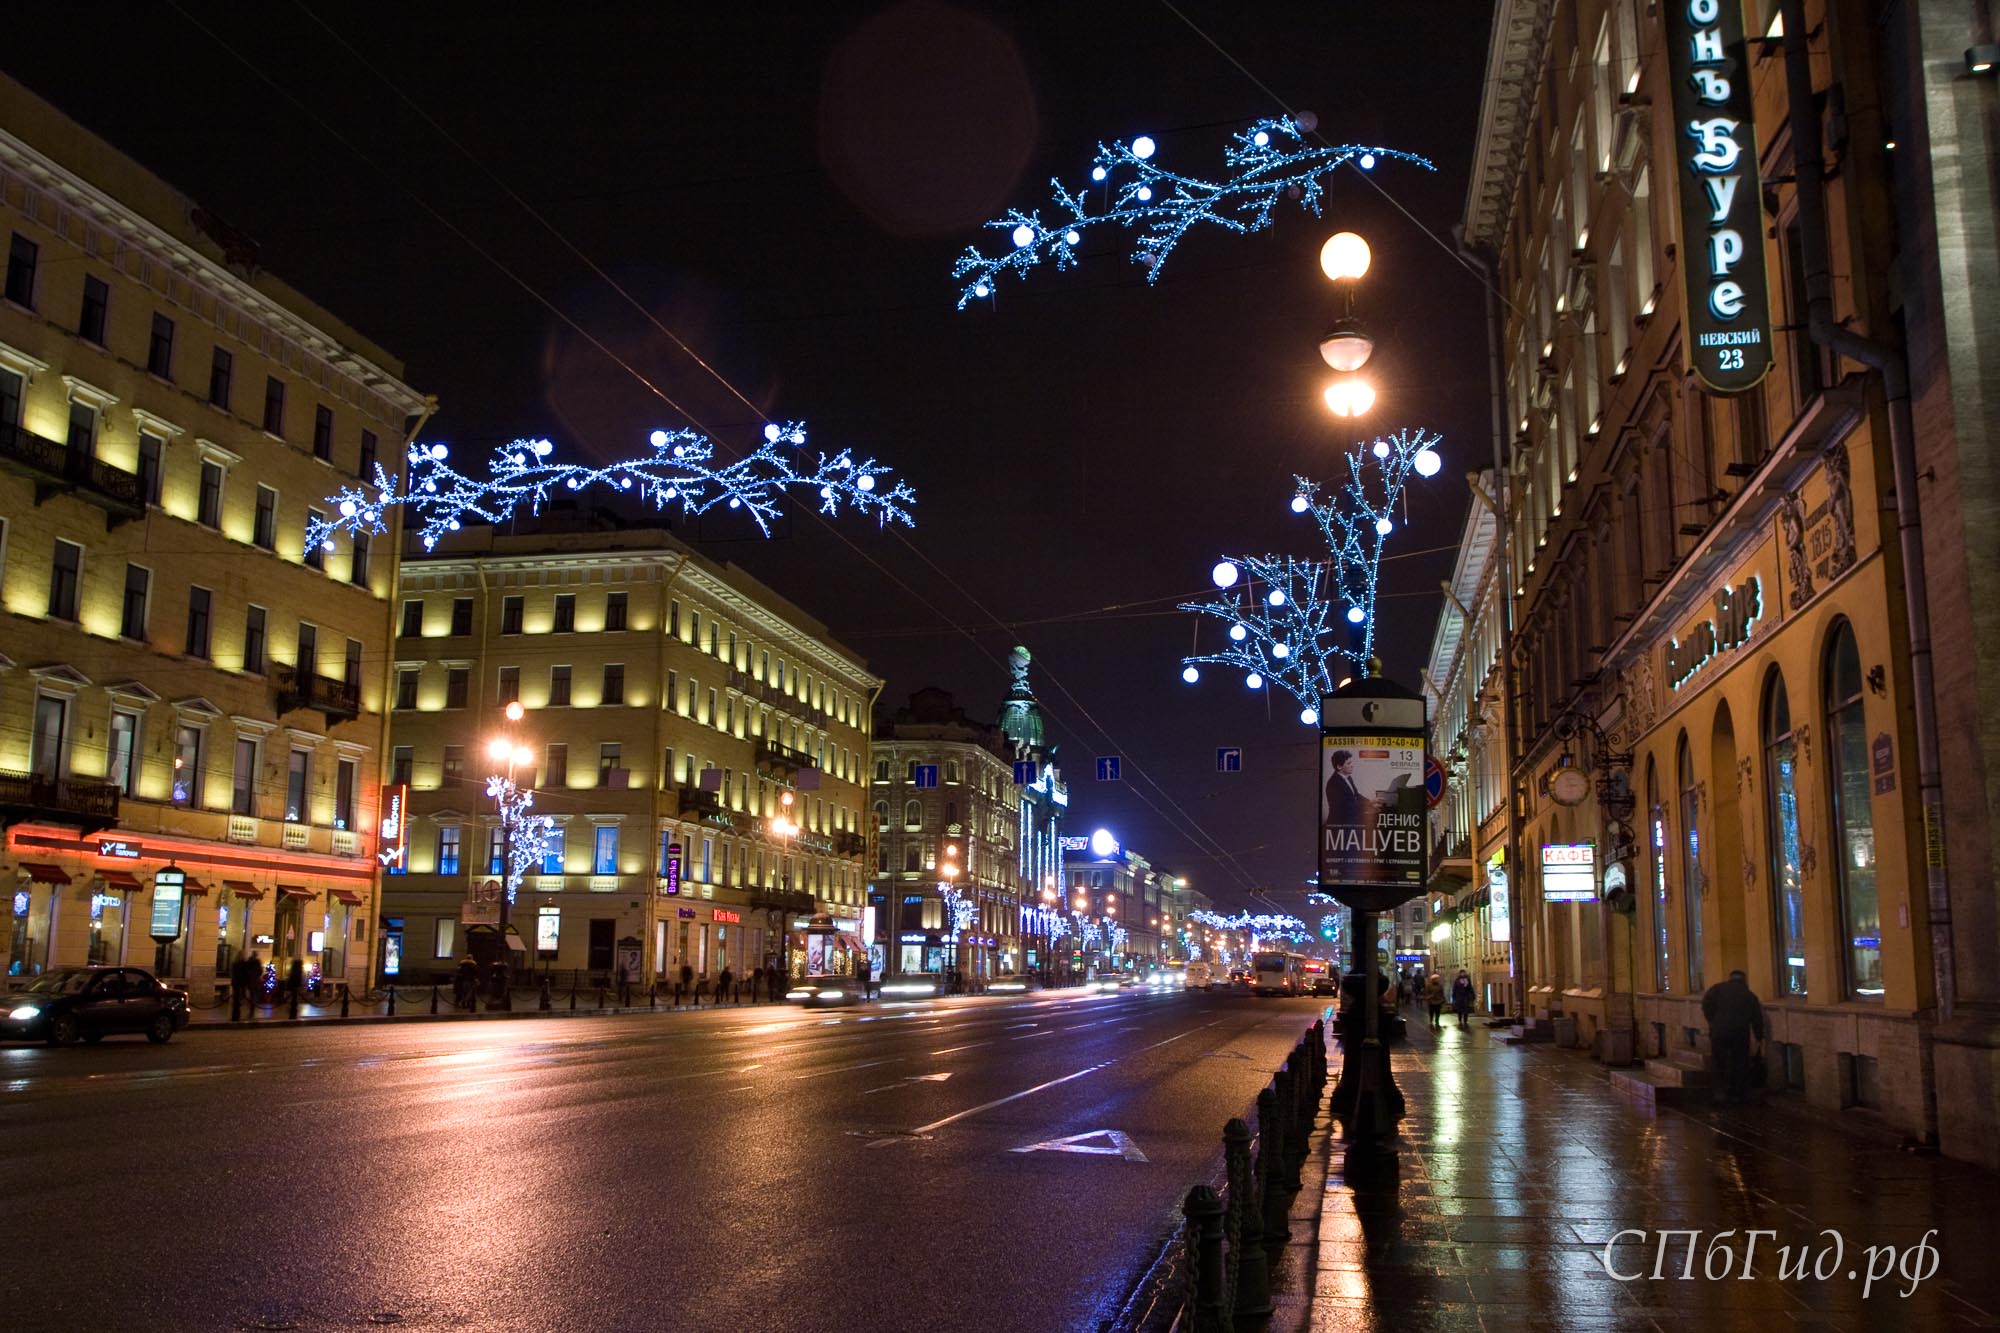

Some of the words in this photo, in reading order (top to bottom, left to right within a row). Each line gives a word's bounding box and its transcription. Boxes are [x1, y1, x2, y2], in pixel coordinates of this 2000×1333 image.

[1687, 117, 1746, 322] Буре
[1700, 328, 1761, 346] НЕВСКИЙ
[1718, 348, 1745, 370] 23
[1399, 751, 1413, 761] 13
[1377, 813, 1421, 828] ДЕНИС
[1325, 829, 1421, 856] МАЦУЕВ
[1545, 849, 1591, 862] КАФЕ
[668, 859, 677, 893] Bershka
